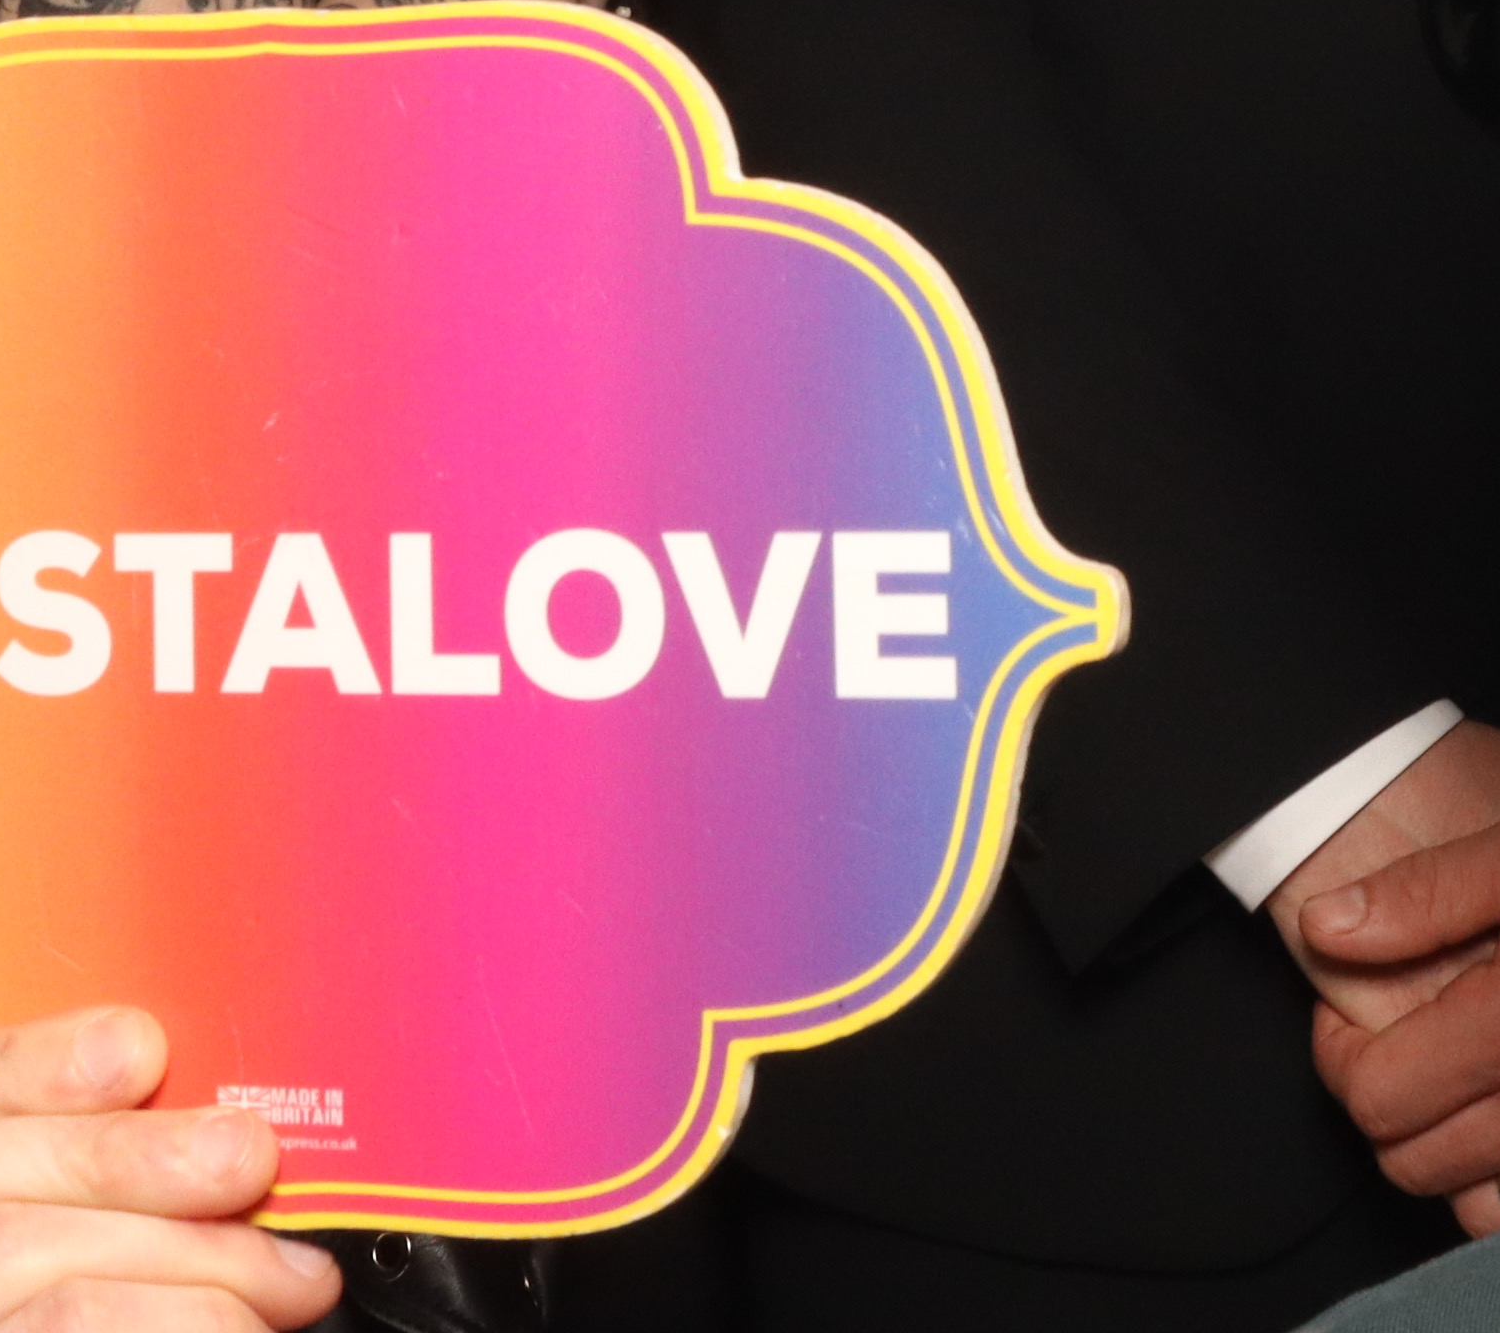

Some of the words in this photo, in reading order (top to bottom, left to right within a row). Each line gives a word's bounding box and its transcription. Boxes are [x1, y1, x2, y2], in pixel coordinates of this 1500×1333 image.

[271, 1088, 319, 1107] MADE
[325, 1089, 344, 1108] IN
[271, 1107, 344, 1127] BRITAIN
[279, 1136, 357, 1151] xpress.co.uk
